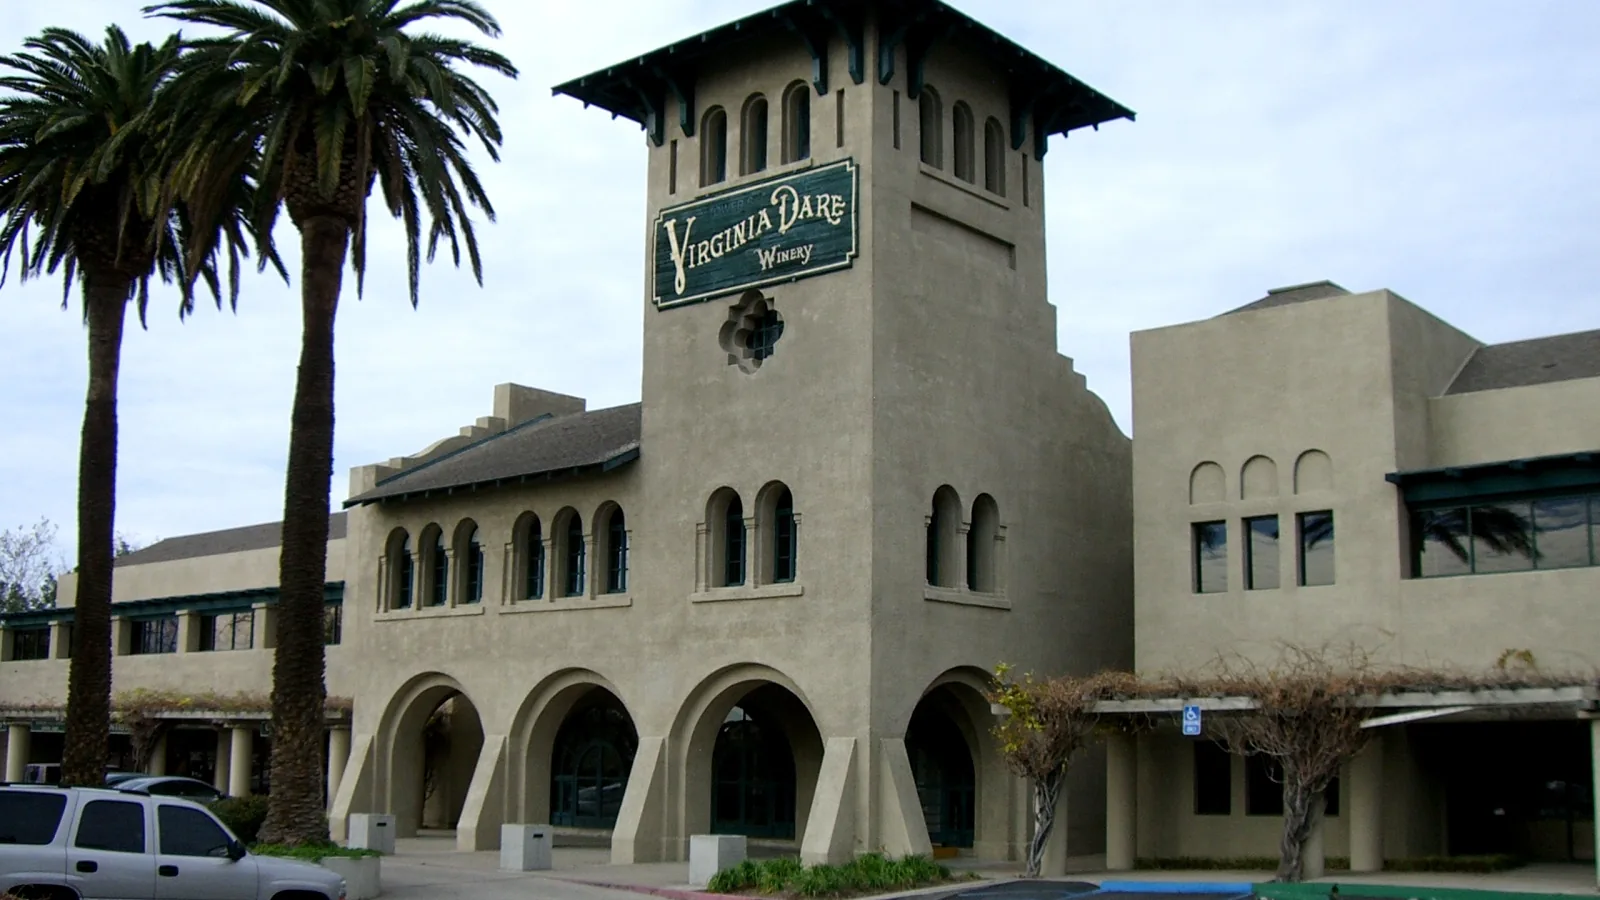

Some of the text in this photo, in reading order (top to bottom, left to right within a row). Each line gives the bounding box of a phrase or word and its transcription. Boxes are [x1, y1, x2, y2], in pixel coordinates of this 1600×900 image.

[663, 185, 846, 295] VIRGINIA DARE
[754, 243, 813, 270] WINERY
